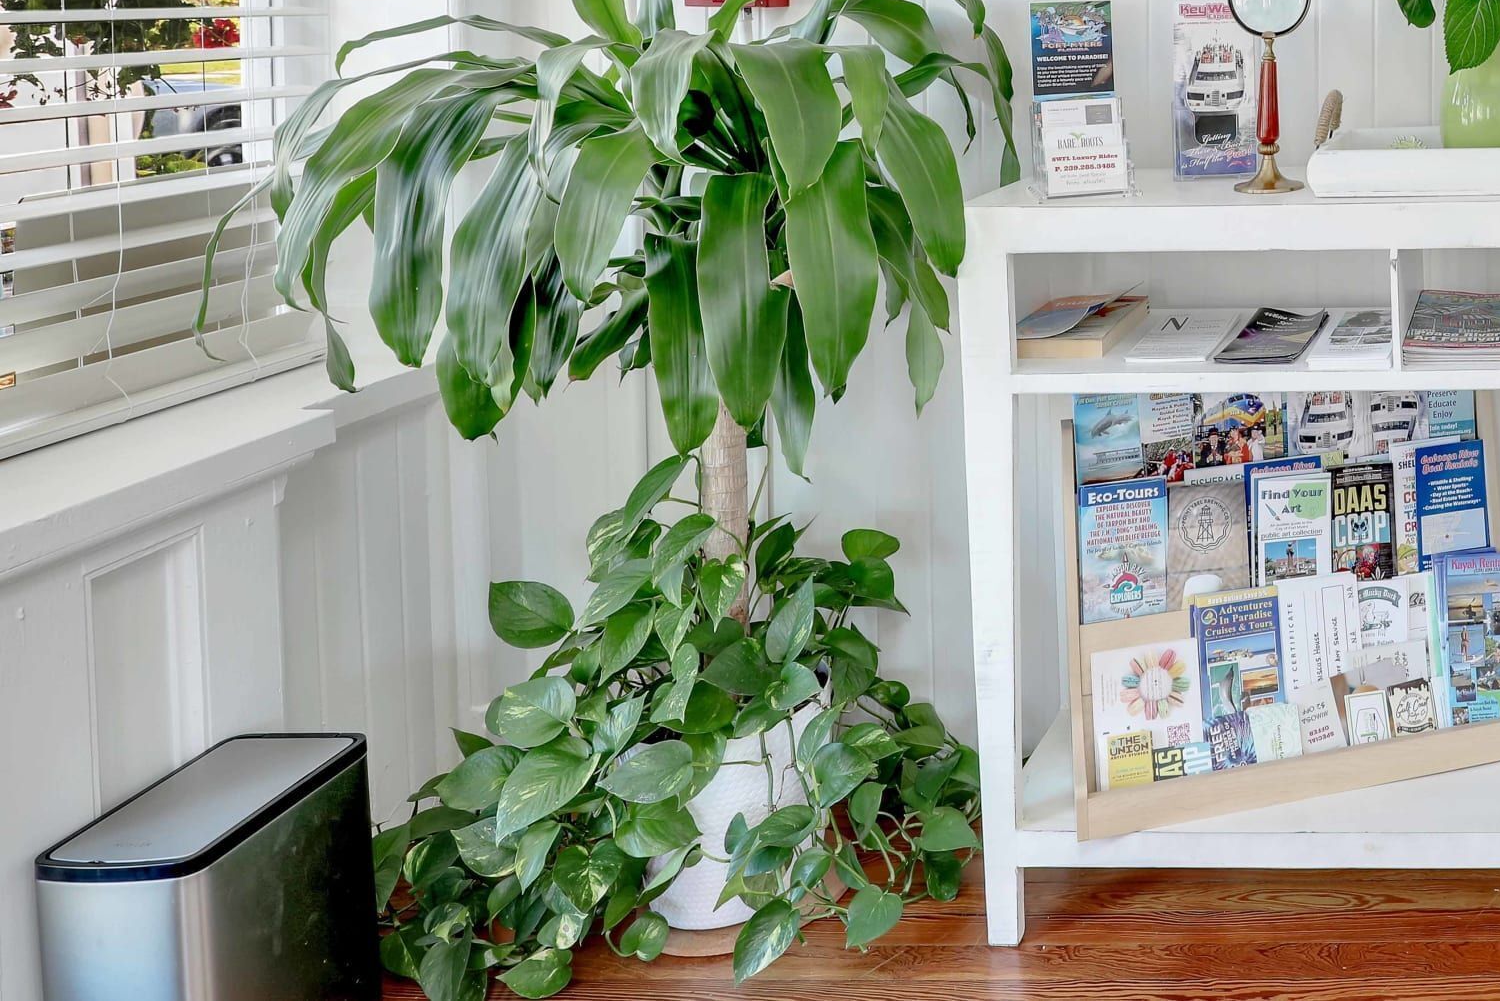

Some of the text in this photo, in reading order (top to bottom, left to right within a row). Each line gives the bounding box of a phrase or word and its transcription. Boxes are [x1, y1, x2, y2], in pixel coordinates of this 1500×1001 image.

[1429, 400, 1457, 408] Educate
[1433, 410, 1453, 419] Enjoy
[1261, 489, 1324, 500] Find Your
[1334, 484, 1387, 515] DAAS
[1281, 504, 1302, 514] Art
[1451, 559, 1478, 573] Kayak
[1219, 601, 1272, 615] Adventures
[1220, 610, 1272, 625] In Paradise
[1205, 620, 1273, 637] Cruises & Tours
